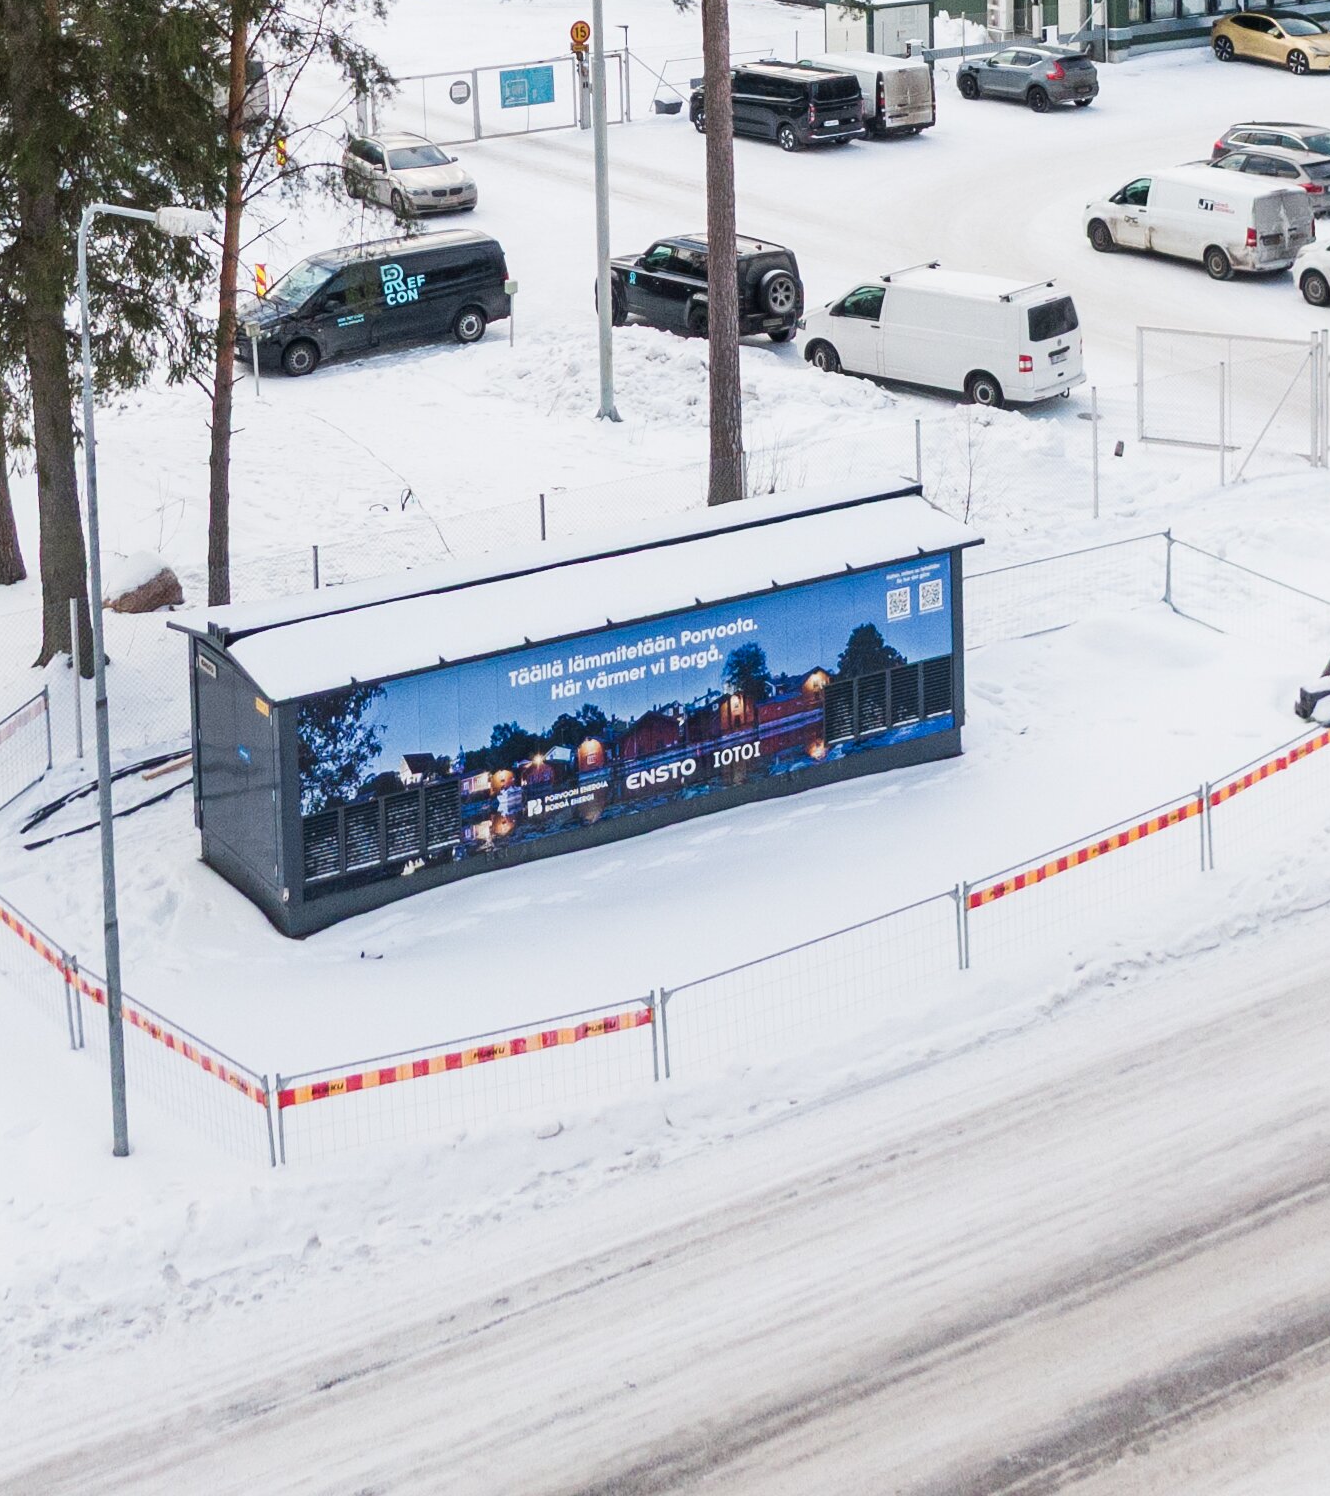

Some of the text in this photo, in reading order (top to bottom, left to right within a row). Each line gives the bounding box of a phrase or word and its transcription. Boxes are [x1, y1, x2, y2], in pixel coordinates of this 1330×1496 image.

[575, 25, 587, 39] 15
[1198, 199, 1214, 211] JT
[386, 288, 419, 305] CON
[508, 617, 759, 687] Täällä lämmitetään Porvoota.
[551, 644, 724, 700] Här värmer vi Borgå.
[713, 741, 761, 768] IOTOI
[625, 758, 697, 790] ENSTO
[544, 780, 609, 803] PORVOON ENERGIA
[544, 793, 595, 812] BORGÅ ENERGI
